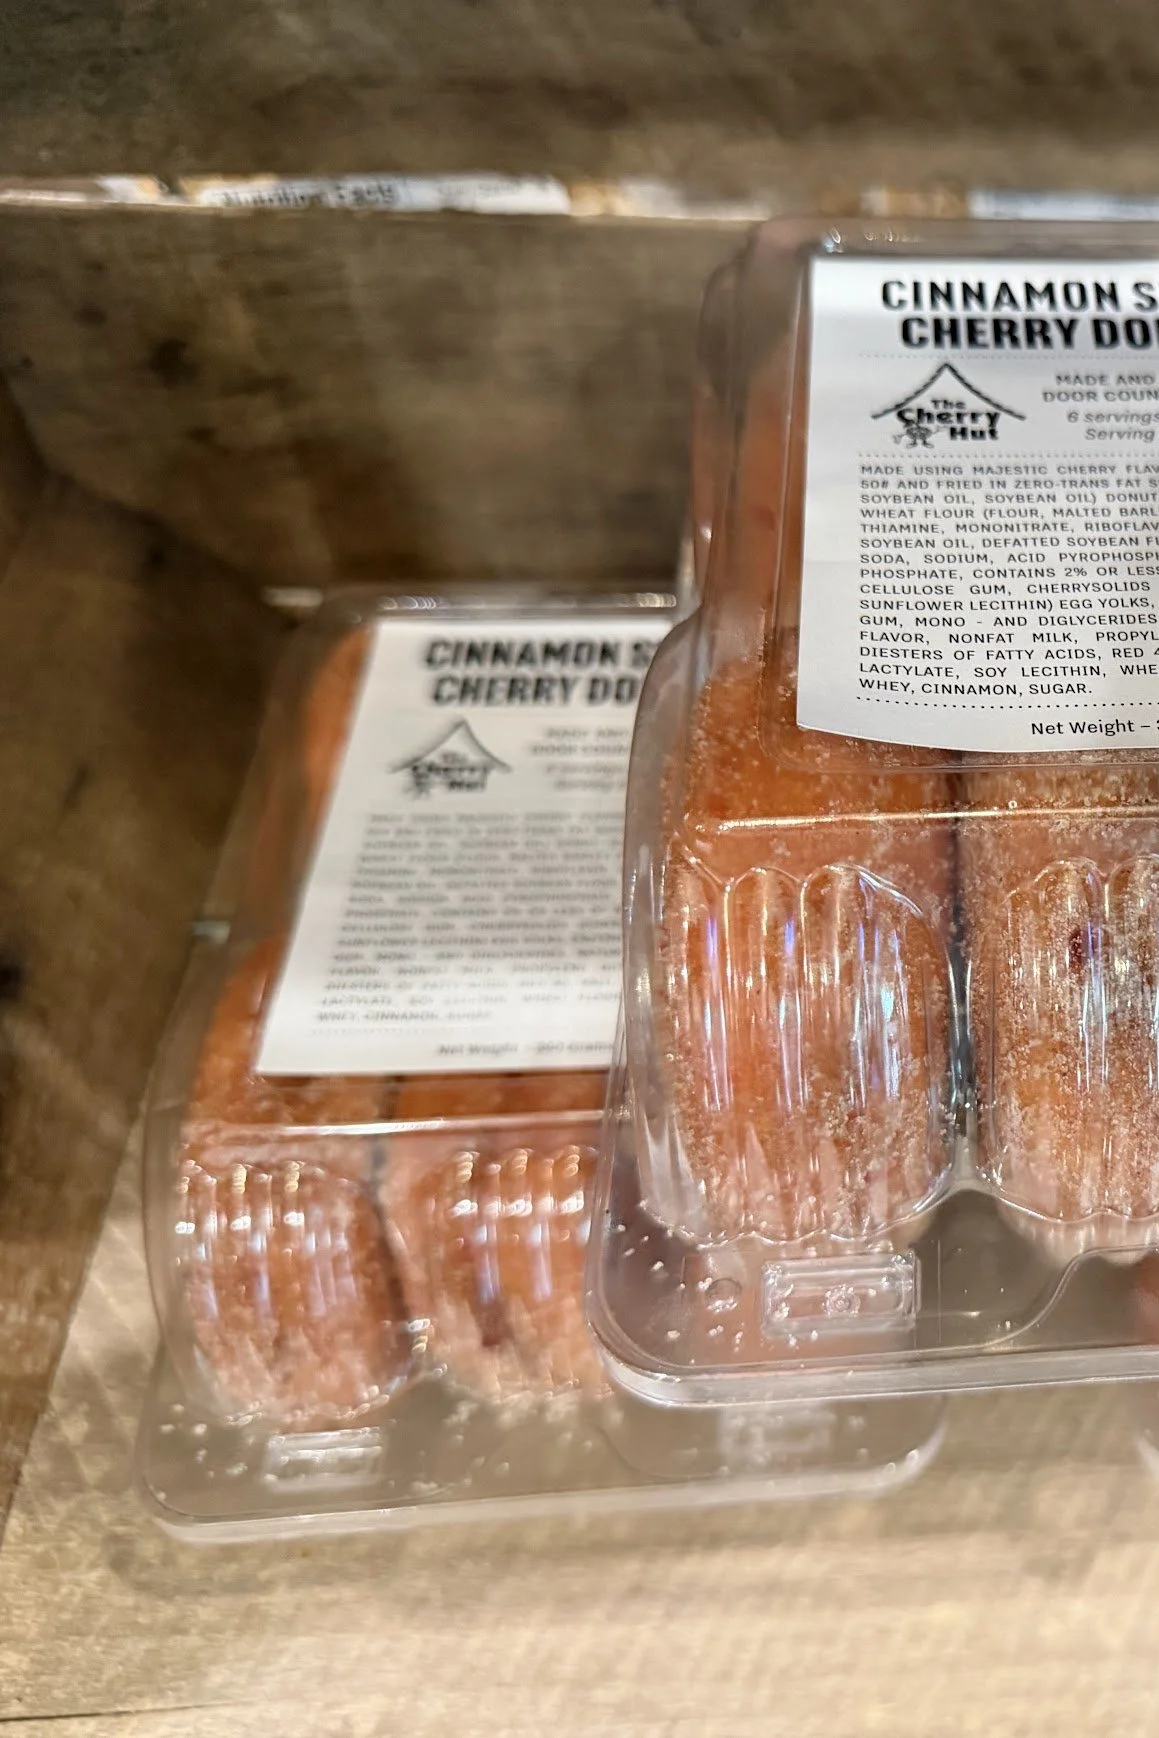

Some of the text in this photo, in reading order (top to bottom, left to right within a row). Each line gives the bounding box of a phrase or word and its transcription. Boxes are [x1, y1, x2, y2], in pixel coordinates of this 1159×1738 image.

[881, 280, 1120, 312] CINNAMON
[901, 317, 1080, 349] CHERRY
[1055, 375, 1108, 385] MADE
[1116, 375, 1155, 386] AND
[931, 399, 965, 409] The
[1042, 391, 1098, 403] DOOR
[897, 408, 1000, 428] Cherry
[1067, 411, 1078, 423] 6
[950, 427, 999, 440] Hut
[1085, 428, 1154, 443] Serving
[861, 465, 903, 476] MADE
[914, 465, 963, 476] USING
[973, 465, 1048, 475] MAJESTIC
[1057, 465, 1116, 475] CHERRY
[861, 479, 888, 489] 50#
[897, 480, 929, 490] AND
[937, 480, 982, 490] FRIED
[990, 480, 1006, 489] IN
[1015, 479, 1109, 489] ZERO-TRANS
[1116, 479, 1141, 488] FAT
[861, 494, 934, 504] SOYBEAN
[943, 494, 975, 506] OIL,
[985, 494, 1056, 504] SOYBEAN
[1066, 493, 1097, 505] OIL)
[861, 509, 915, 519] WHEAT
[924, 509, 974, 518] FLOUR
[983, 508, 1044, 521] (FLOUR,
[1052, 507, 1111, 518] MALTED
[861, 523, 945, 535] THIAMINE,
[956, 522, 1074, 534] MONONITRATE,
[861, 538, 935, 549] SOYBEAN
[943, 538, 975, 550] OIL,
[983, 537, 1059, 547] DEFATTED
[1067, 536, 1139, 547] SOYBEAN
[860, 553, 910, 566] SODA,
[924, 553, 994, 565] SODIUM,
[1007, 553, 1045, 563] ACID
[861, 569, 963, 581] PHOSPHATE,
[973, 568, 1055, 578] CONTAINS
[1064, 568, 1087, 577] 2%
[1097, 567, 1118, 576] OR
[860, 584, 954, 595] CELLULOSE
[969, 585, 1012, 597] GUM,
[1027, 581, 1150, 594] CHERRYSOLIDS
[860, 600, 963, 611] SUNFLOWER
[970, 599, 1053, 612] LECITHIN)
[1060, 599, 1093, 610] EGG
[1100, 597, 1155, 610] YOLKS,
[860, 616, 903, 628] GUM,
[915, 617, 966, 627] MONO
[993, 617, 1027, 627] AND
[860, 631, 930, 645] FLAVOR,
[949, 633, 1014, 644] NONFAT
[1032, 632, 1078, 644] MILK,
[425, 640, 621, 668] CINNAMON
[860, 647, 943, 661] DIESTERS
[953, 650, 975, 661] OF
[986, 649, 1034, 660] FATTY
[1045, 648, 1102, 661] ACIDS,
[1112, 647, 1145, 659] RED
[860, 662, 960, 679] LACTYLATE,
[974, 666, 1007, 677] SOY
[1022, 665, 1106, 677] LECITHIN,
[432, 676, 639, 703] CHERRY DO
[859, 678, 1092, 697] WHEY, CINNAMON, SUGAR.
[1031, 722, 1064, 735] Net
[1069, 719, 1135, 736] Weight
